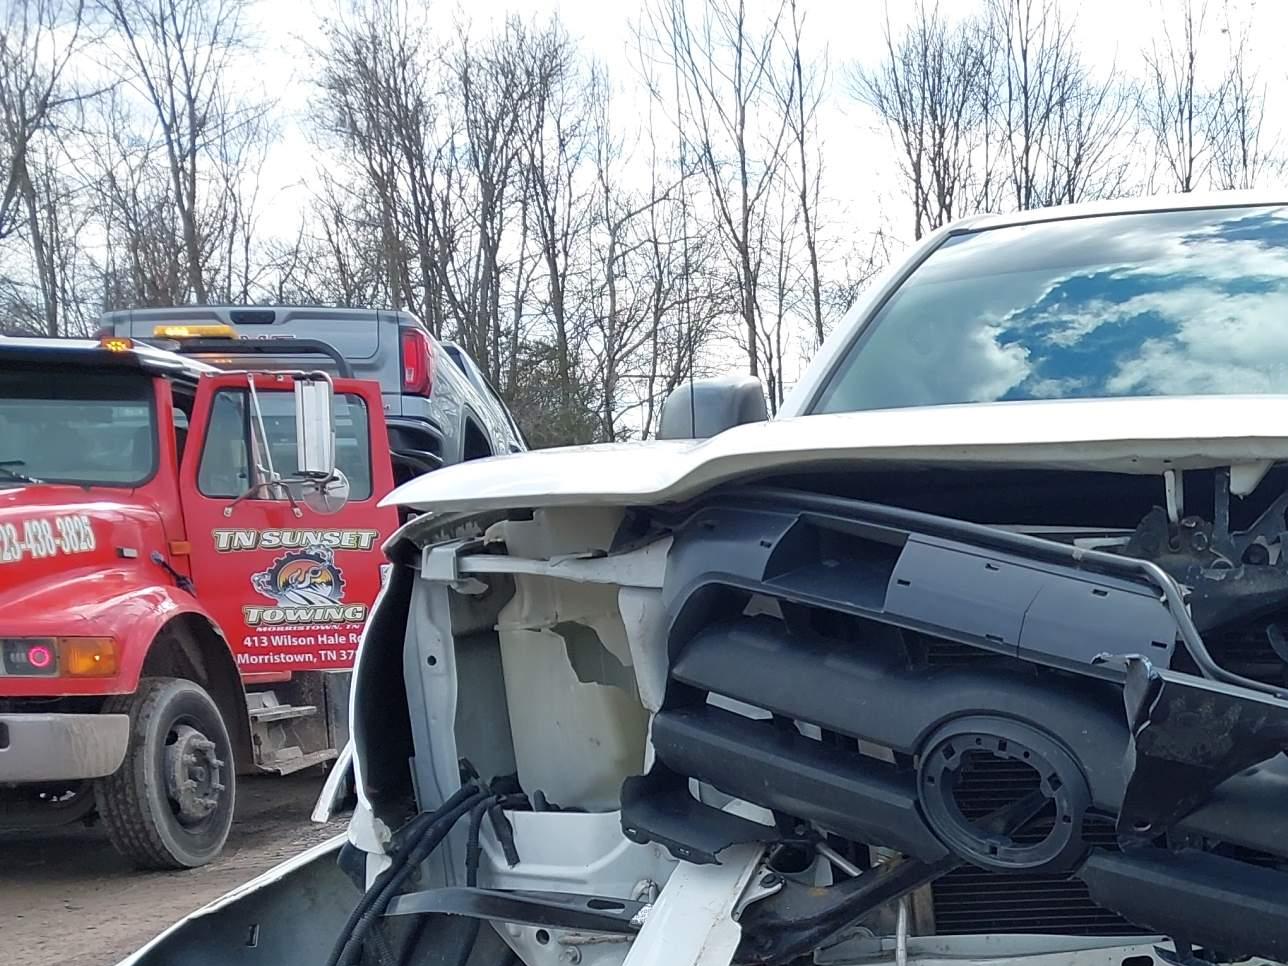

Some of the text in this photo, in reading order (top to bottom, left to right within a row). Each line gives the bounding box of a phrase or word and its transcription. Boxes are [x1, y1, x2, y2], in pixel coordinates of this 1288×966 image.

[213, 529, 378, 551] TN SUNSET
[243, 604, 366, 626] TOWING
[243, 636, 268, 647] 413
[270, 635, 315, 646] Wilson
[317, 634, 346, 645] Hale
[237, 653, 318, 664] Morristown,
[319, 651, 336, 661] TN
